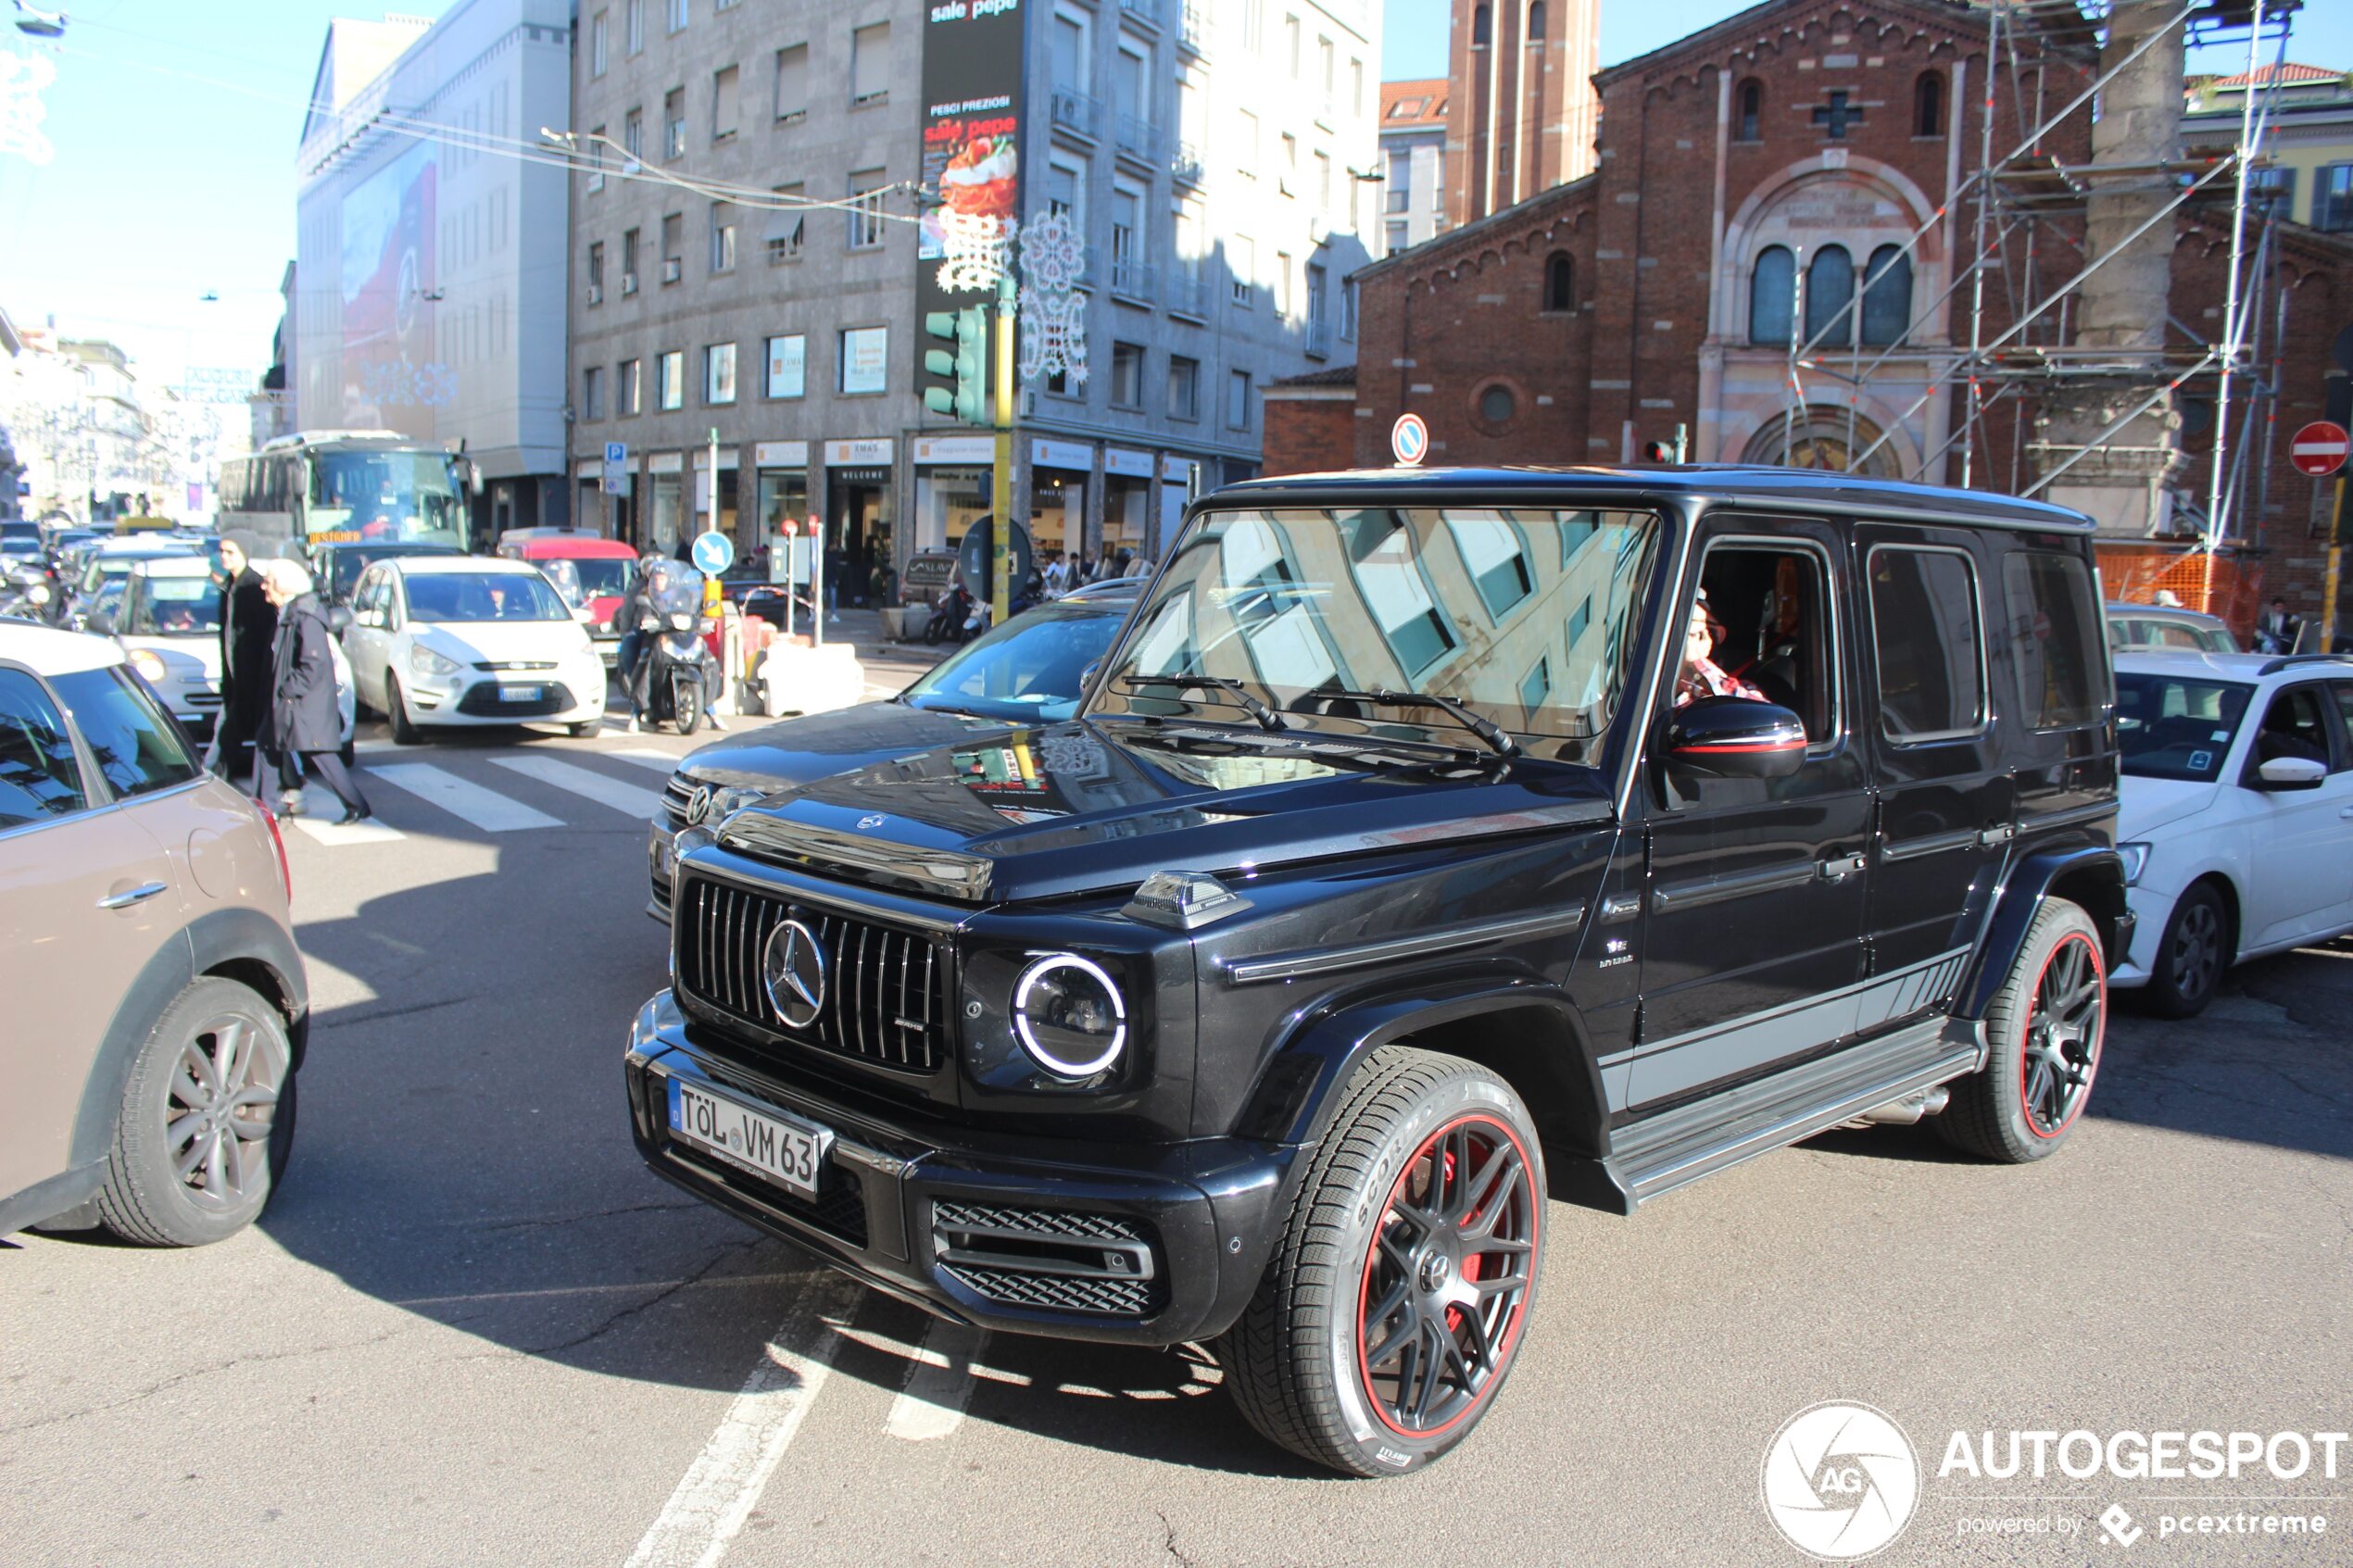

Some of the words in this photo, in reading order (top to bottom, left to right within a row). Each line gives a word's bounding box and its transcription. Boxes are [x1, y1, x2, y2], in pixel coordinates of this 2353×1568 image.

[931, 0, 966, 22] sale
[972, 0, 1018, 19] pepe
[930, 102, 961, 117] PESCI
[962, 94, 1011, 112] PREZIOSI
[967, 117, 1016, 140] pepe
[854, 443, 878, 453] XMAS
[842, 470, 882, 480] WELCOME
[681, 1089, 726, 1146] TÖL
[1376, 1446, 1412, 1467] PIRELLI
